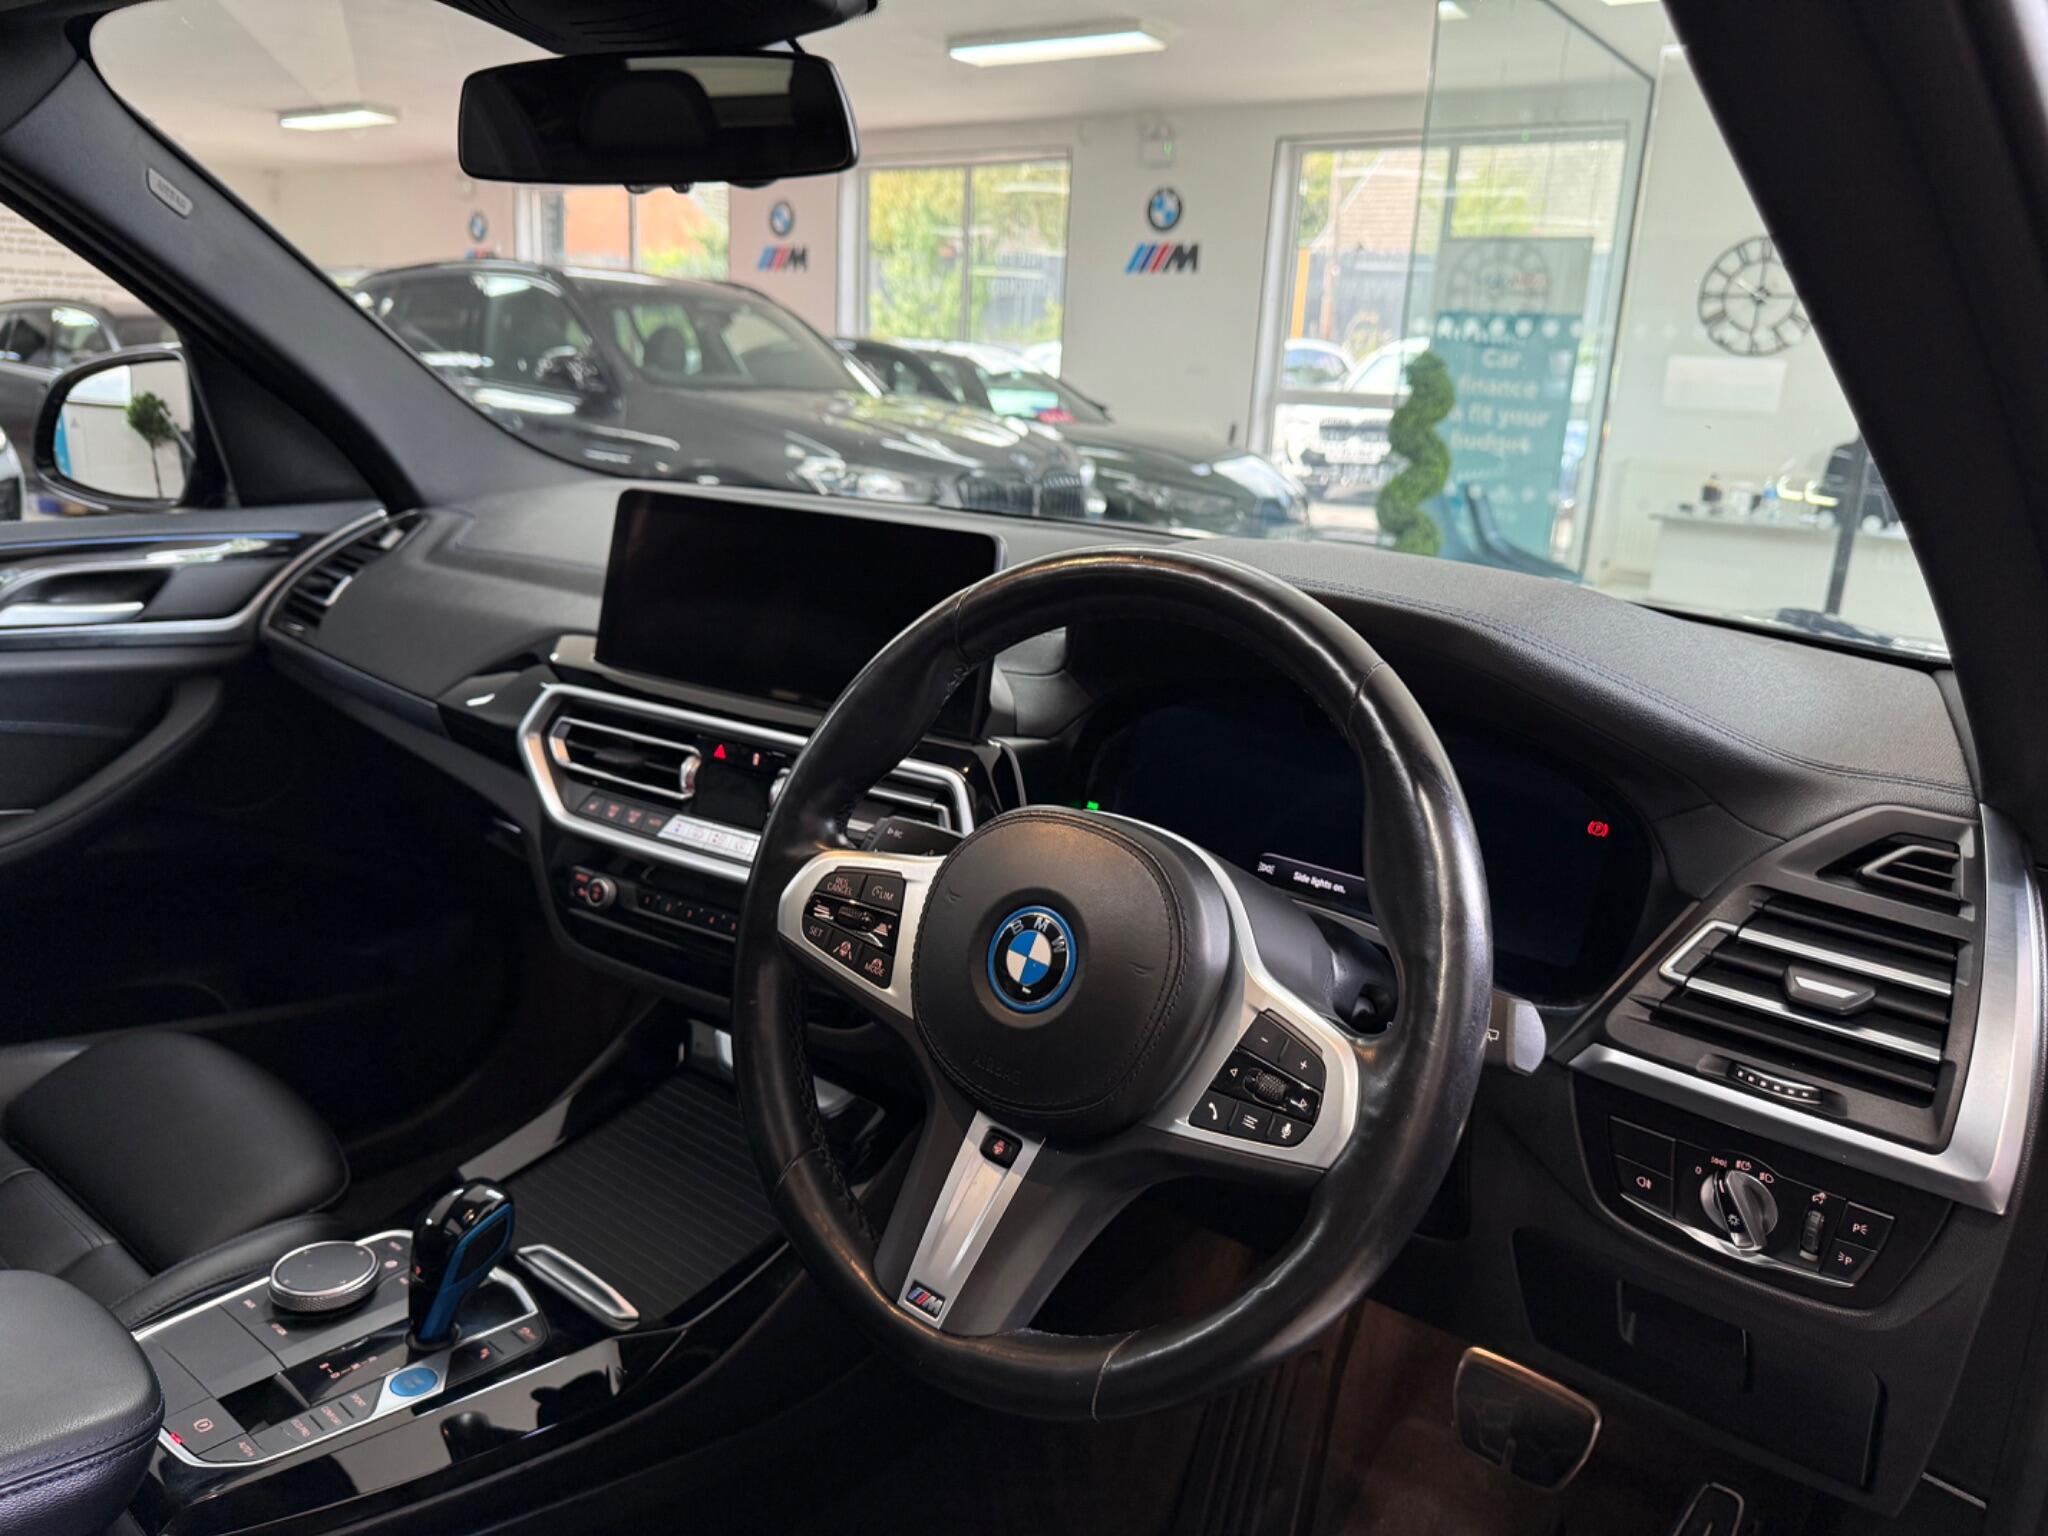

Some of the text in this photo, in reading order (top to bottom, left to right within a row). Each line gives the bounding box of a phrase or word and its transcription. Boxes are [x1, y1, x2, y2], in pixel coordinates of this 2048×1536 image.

[1293, 871, 1310, 884] Side
[1310, 876, 1332, 889] lights
[808, 925, 824, 938] SET
[1009, 916, 1066, 953] BMW
